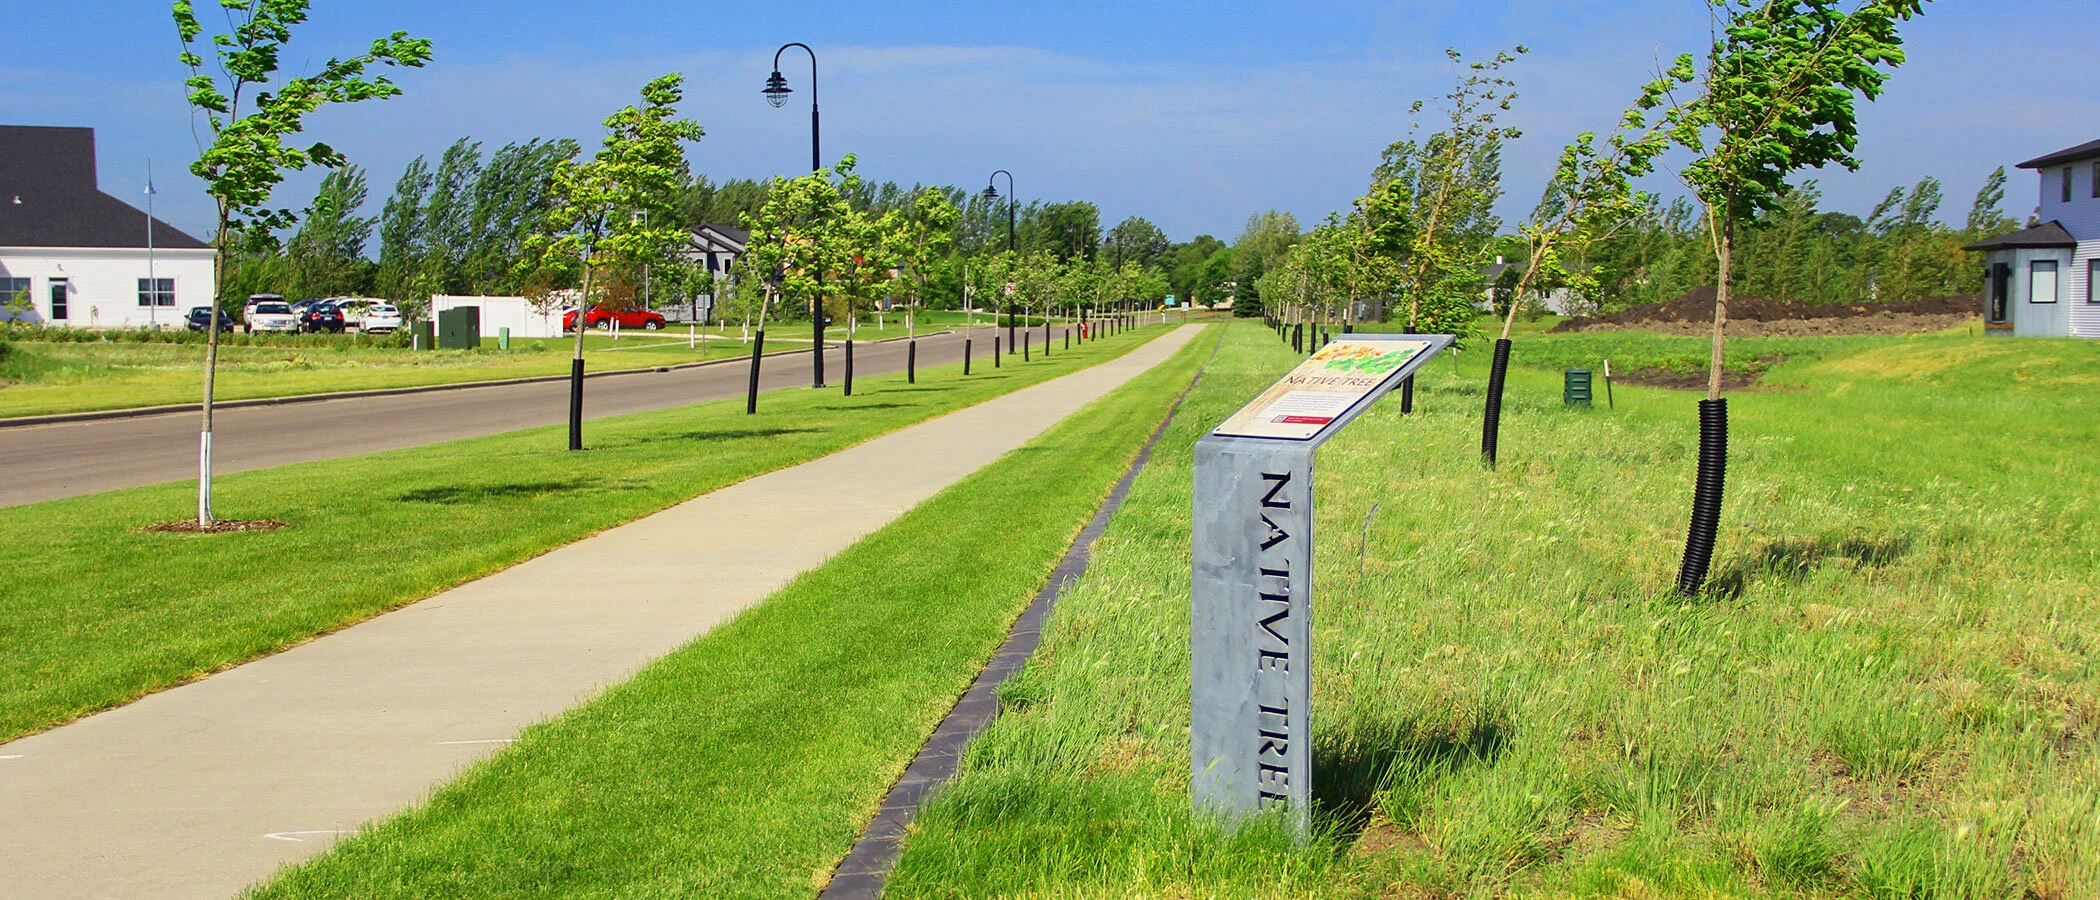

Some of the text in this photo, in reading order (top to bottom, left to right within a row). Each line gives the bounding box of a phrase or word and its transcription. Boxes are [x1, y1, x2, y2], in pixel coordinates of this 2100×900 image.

[1283, 376, 1376, 386] NATIVE TREE
[1257, 470, 1291, 813] NATIVE TREE
